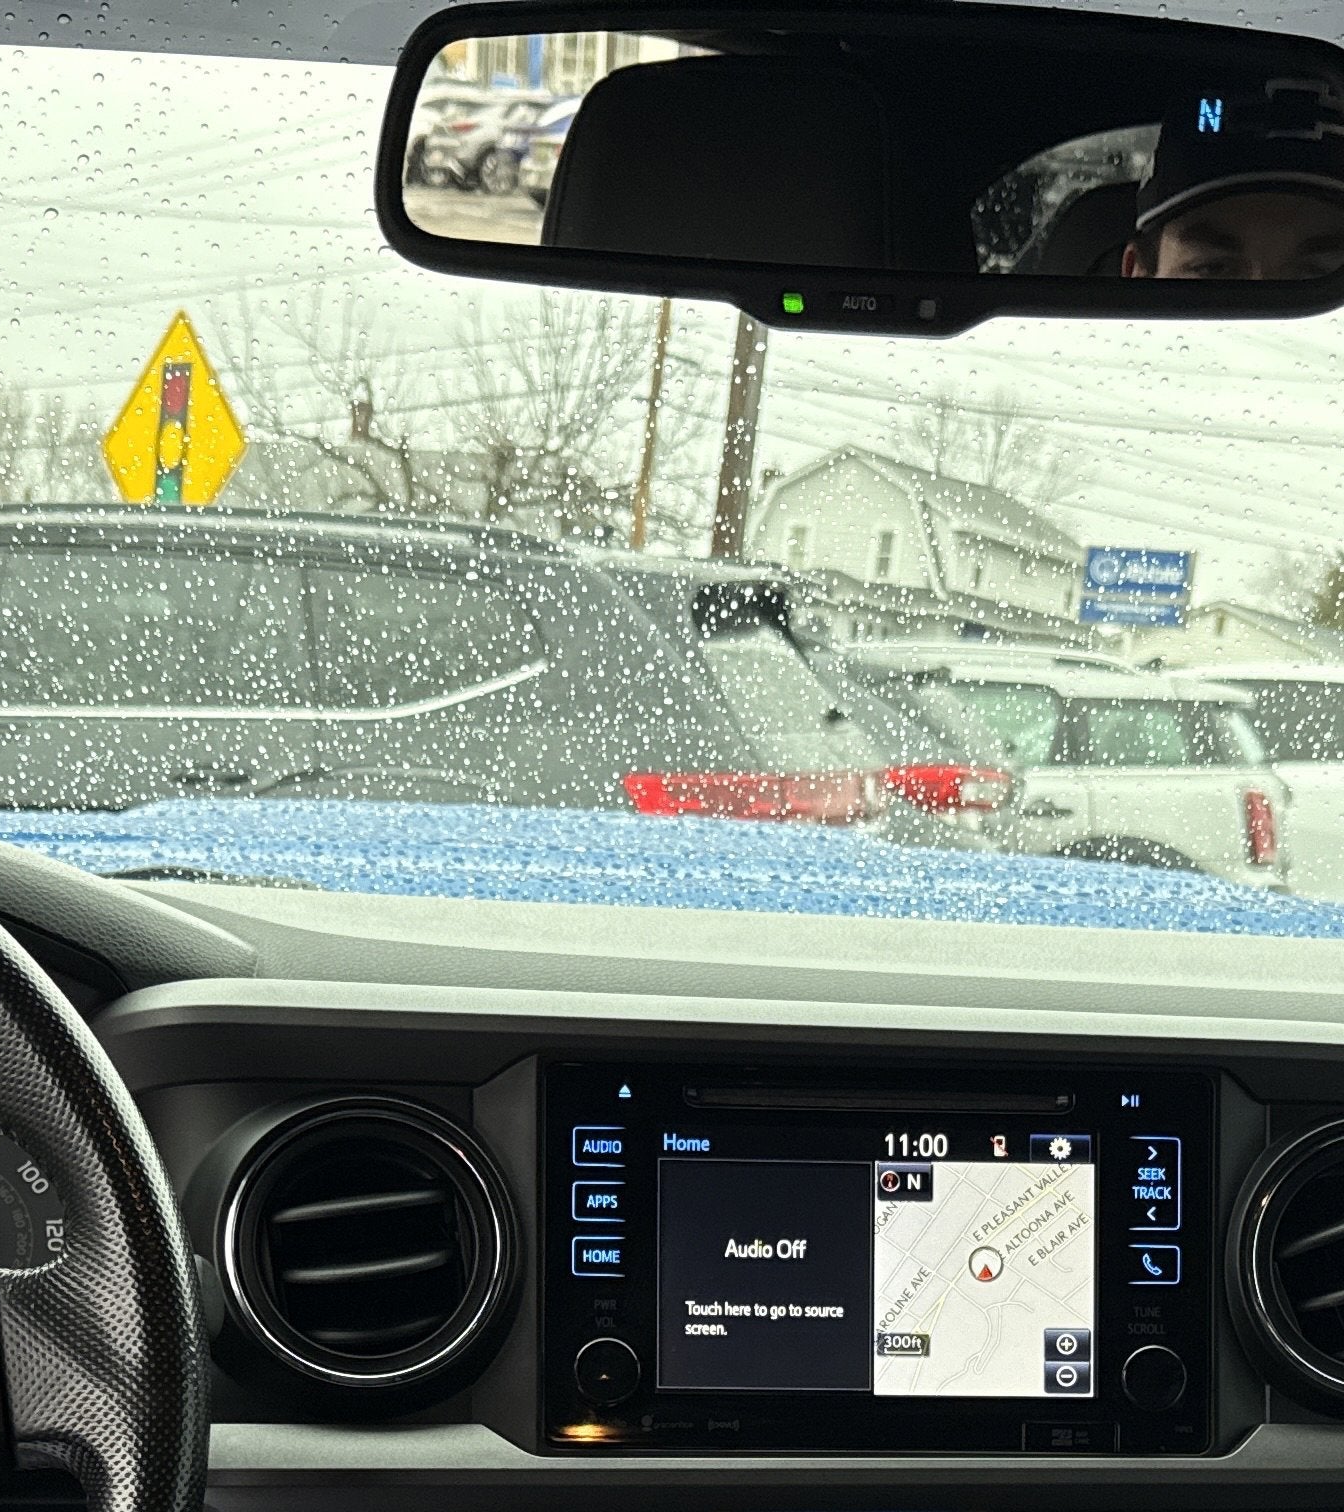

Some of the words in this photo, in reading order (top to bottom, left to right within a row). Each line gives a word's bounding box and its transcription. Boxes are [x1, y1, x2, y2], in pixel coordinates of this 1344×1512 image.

[1198, 98, 1222, 133] N
[842, 295, 877, 311] AUTO
[582, 1140, 622, 1154] AUDIO
[663, 1133, 710, 1152] Home
[884, 1133, 948, 1157] 11:00
[16, 1160, 49, 1194] 100
[907, 1174, 922, 1190] N
[1137, 1167, 1166, 1181] SEEK
[1131, 1185, 1172, 1200] TRACK
[586, 1194, 618, 1209] APPS
[973, 1231, 984, 1242] E
[980, 1188, 1035, 1234] PLEASANT
[1034, 1163, 1073, 1191] VALLE
[1002, 1209, 1054, 1254] ALTOONA
[1052, 1189, 1075, 1212] AVE
[45, 1217, 64, 1252] 120
[1027, 1255, 1038, 1267] E
[1036, 1231, 1070, 1260] BLAIR
[1066, 1212, 1089, 1234] AVE
[582, 1249, 621, 1264] HOME
[724, 1239, 773, 1259] Audio
[776, 1239, 807, 1259] Off
[594, 1300, 617, 1310] PWR
[875, 1287, 914, 1334] AROLINE
[911, 1266, 932, 1290] AVE
[685, 1300, 722, 1316] Touch
[725, 1301, 751, 1317] here
[755, 1303, 768, 1317] to
[770, 1306, 786, 1320] go
[789, 1303, 803, 1317] to
[805, 1306, 844, 1318] source
[1133, 1306, 1162, 1317] TUNE
[594, 1317, 617, 1328] VOL
[685, 1324, 728, 1336] screen.
[1128, 1323, 1167, 1335] SCROLL
[883, 1335, 922, 1349] 300ft
